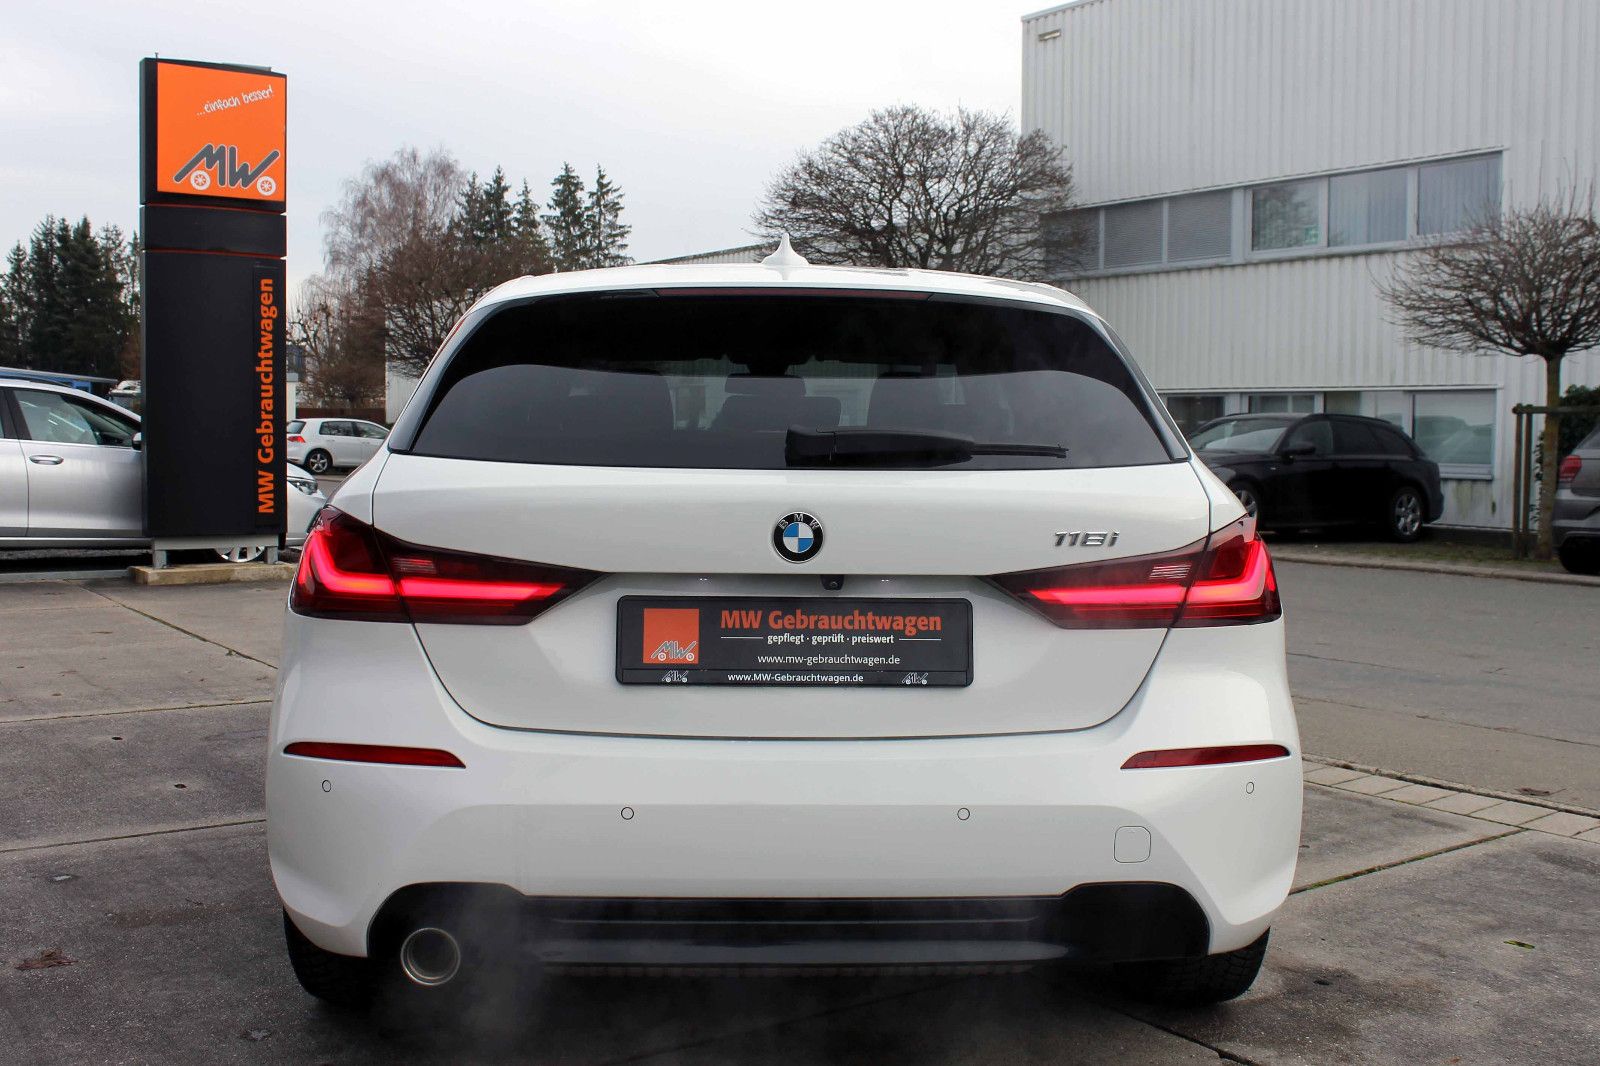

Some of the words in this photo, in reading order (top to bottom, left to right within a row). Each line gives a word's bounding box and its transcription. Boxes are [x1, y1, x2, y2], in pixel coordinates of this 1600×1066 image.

[173, 143, 280, 190] MW
[255, 278, 278, 464] Gebrauchtwagen
[258, 470, 275, 514] MW
[1054, 531, 1120, 547] 118i
[720, 610, 763, 629] MW
[768, 609, 942, 637] Gebrauchtwagen
[767, 633, 804, 645] gepflegt
[811, 633, 845, 645] geprüft
[851, 634, 894, 646] preiswert
[757, 653, 901, 667] www.mw-gebrauchtwagen.de
[727, 672, 864, 685] www.MW-Gebrauchtwagen.de
